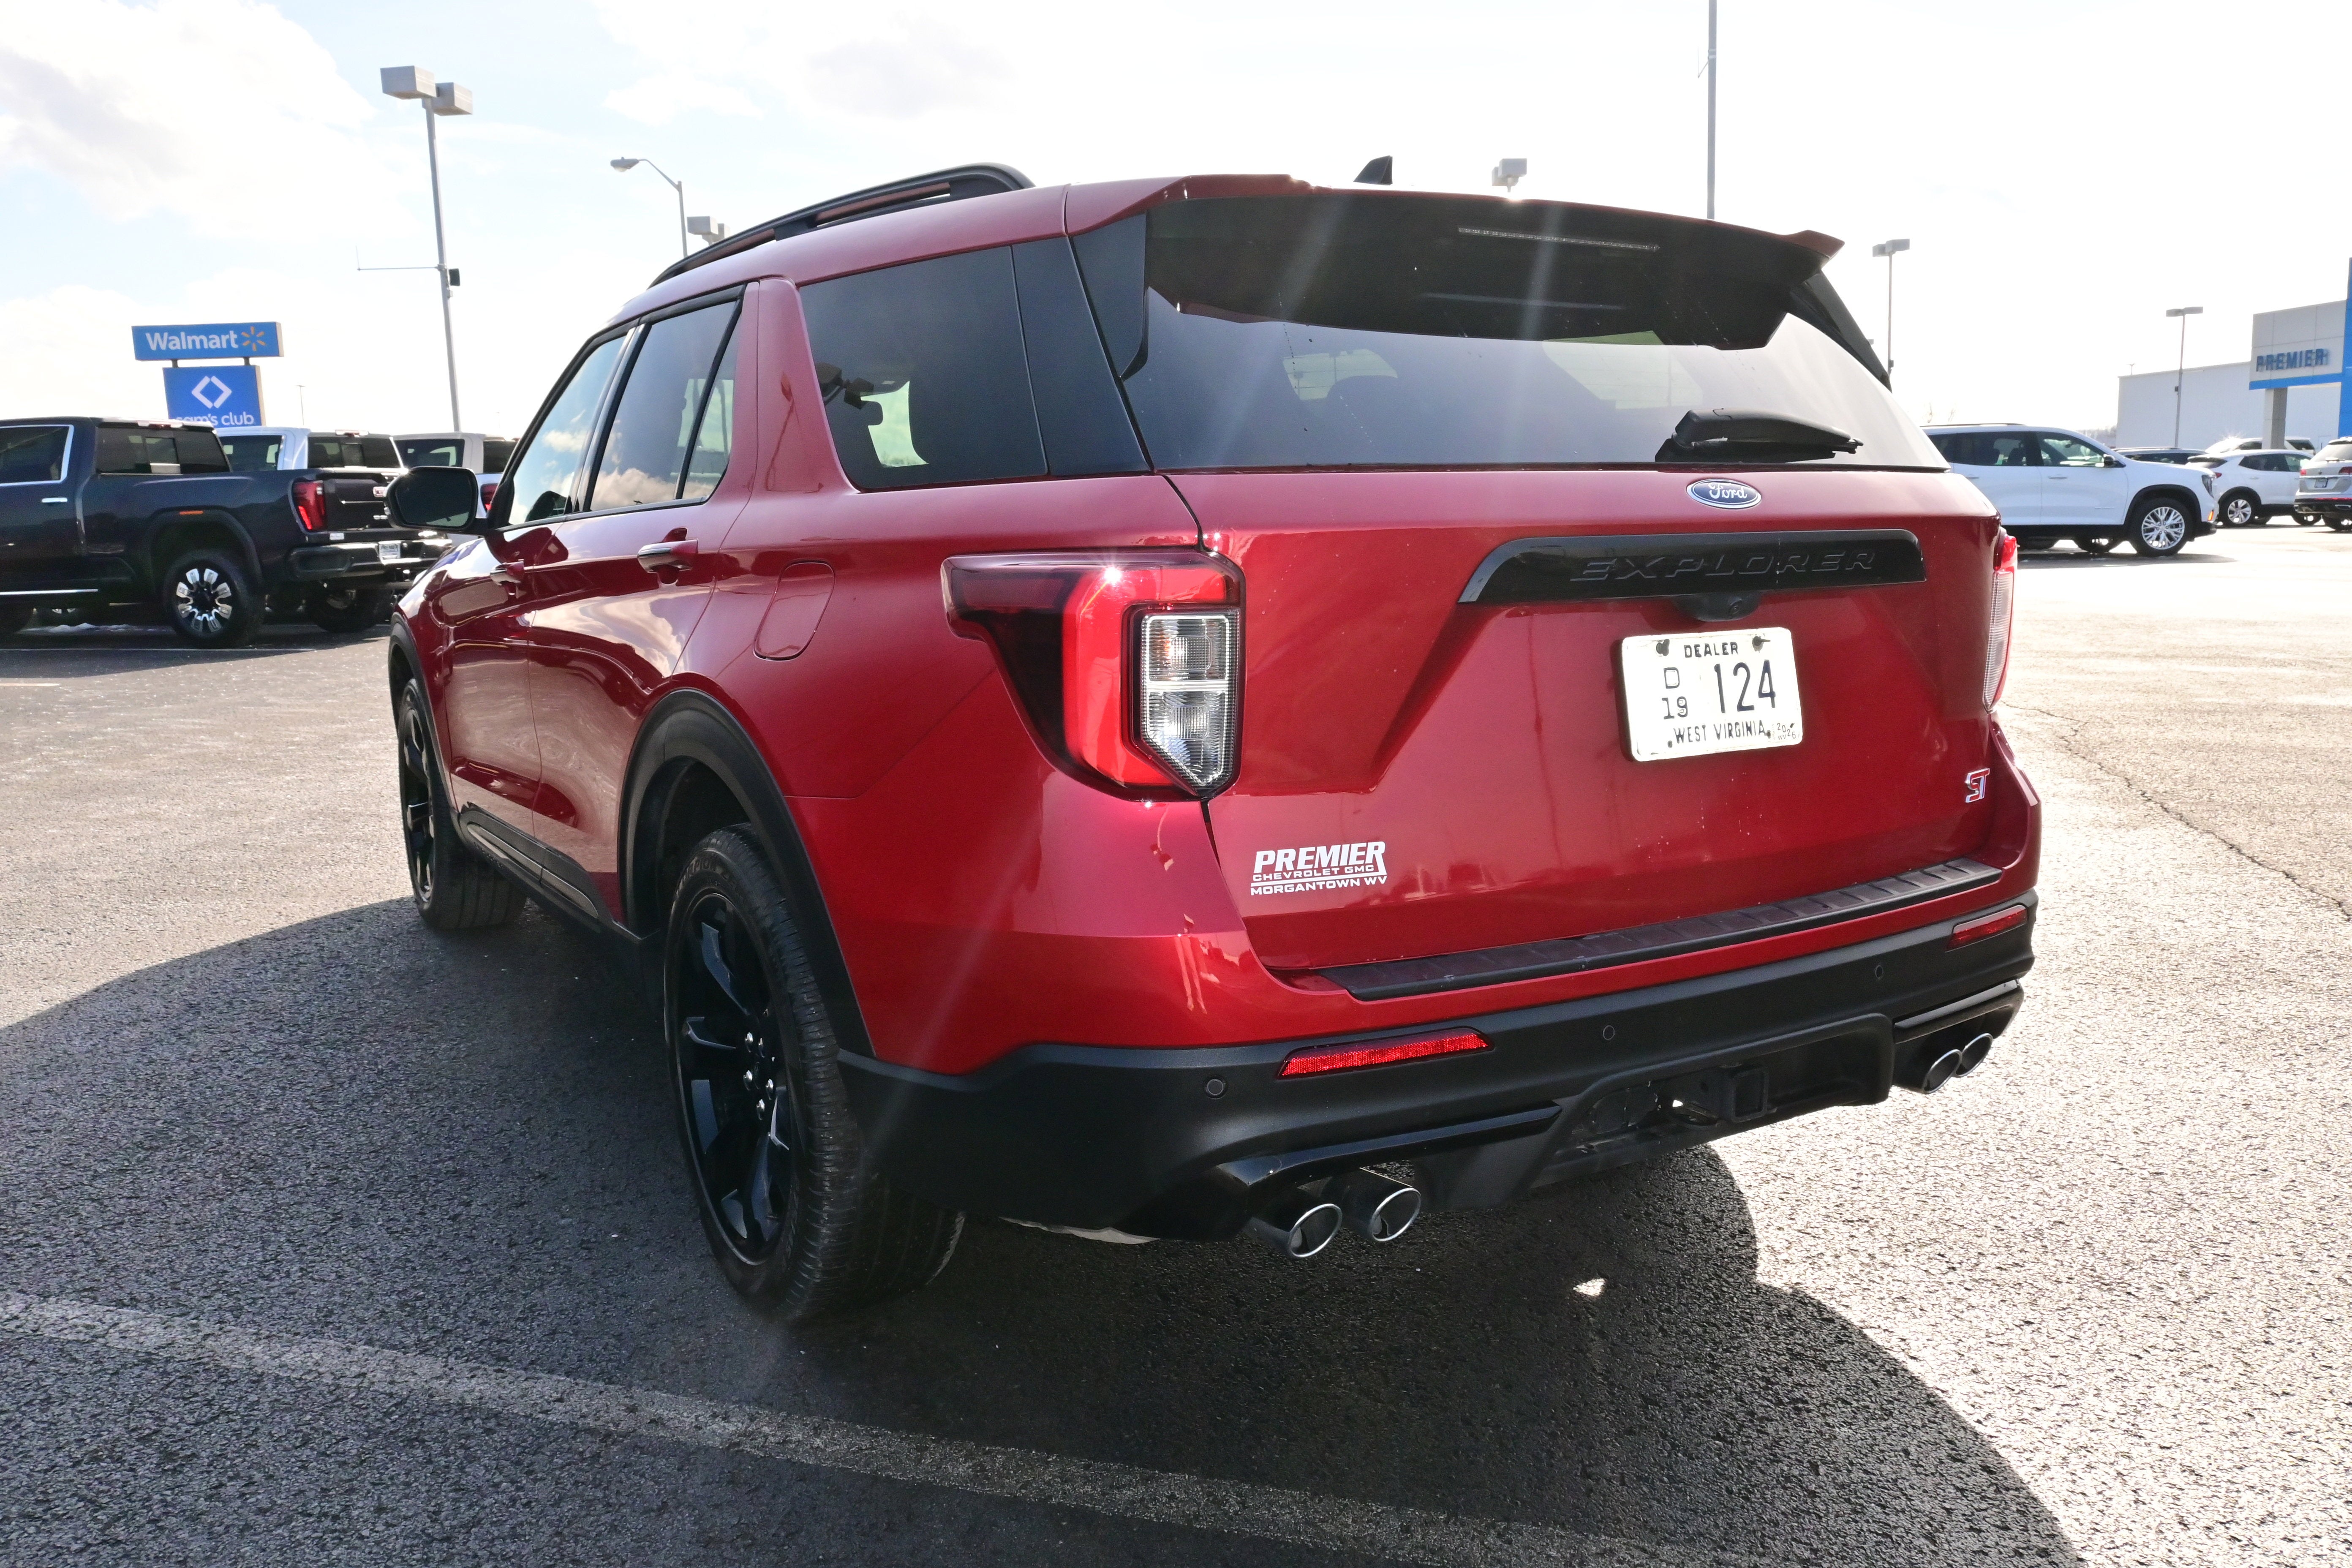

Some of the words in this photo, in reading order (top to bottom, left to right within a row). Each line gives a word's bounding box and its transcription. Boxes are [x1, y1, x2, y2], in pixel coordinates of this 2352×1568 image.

[146, 330, 239, 350] Walmart
[2256, 348, 2329, 372] PREMIER
[221, 411, 254, 425] club
[1708, 482, 1748, 499] Ford
[1570, 551, 1875, 581] EXPLORER
[1684, 642, 1739, 658] DEALER
[1663, 667, 1680, 689] D
[1714, 659, 1776, 714] 124
[1661, 696, 1688, 719] 19
[1673, 724, 1707, 744] WEST
[1713, 719, 1766, 740] VIRGINIA
[1965, 768, 1990, 803] ST
[1253, 841, 1387, 875] PREMIER
[1252, 867, 1340, 882] CHEVROLET
[1344, 865, 1374, 874] GMC
[1250, 878, 1360, 896] MORGANTOWN
[1364, 876, 1387, 885] WV
